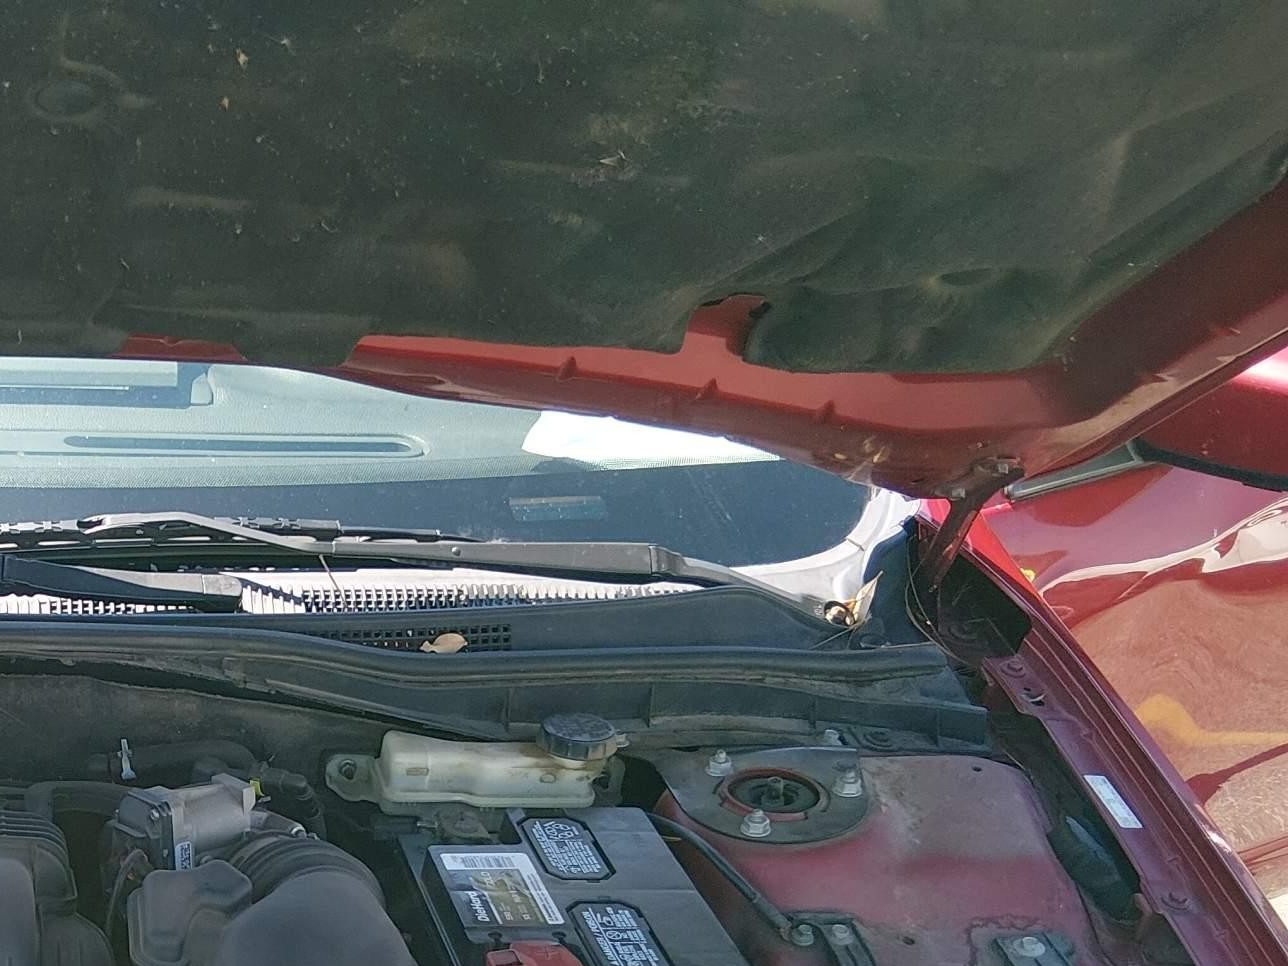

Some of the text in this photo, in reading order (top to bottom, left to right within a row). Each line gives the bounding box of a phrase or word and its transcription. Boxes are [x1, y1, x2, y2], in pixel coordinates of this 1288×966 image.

[465, 891, 491, 922] DieHard
[581, 911, 601, 932] POISON
[595, 937, 617, 961] DANGER
